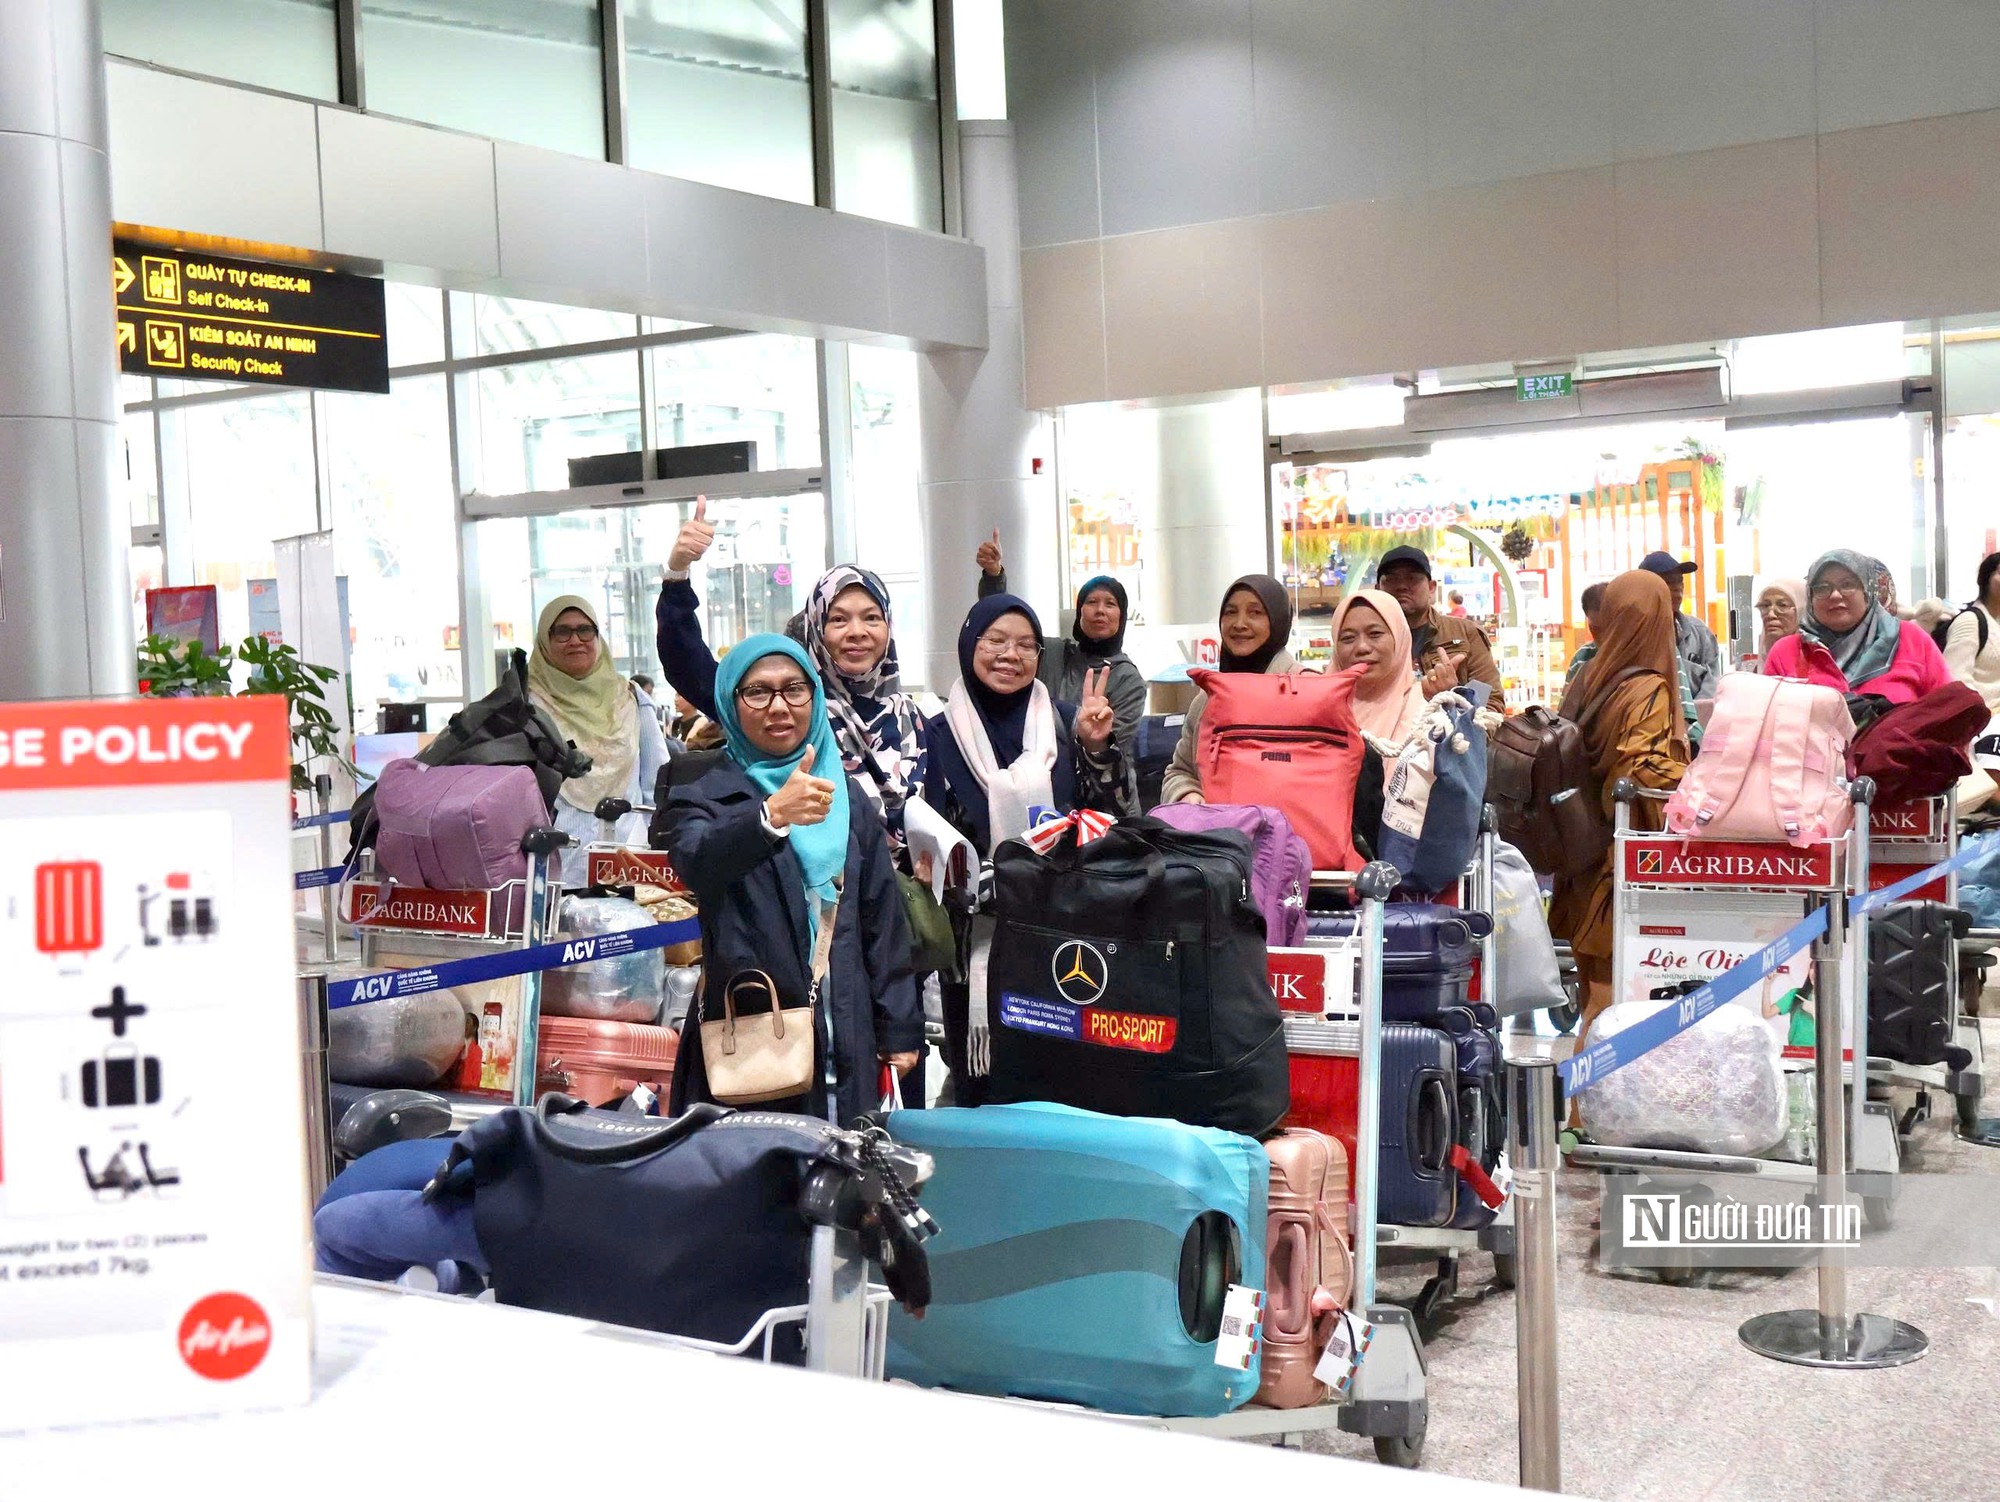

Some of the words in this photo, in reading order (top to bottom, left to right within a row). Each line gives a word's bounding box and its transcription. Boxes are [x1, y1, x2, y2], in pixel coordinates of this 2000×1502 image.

[250, 273, 311, 293] CHECK-IN
[187, 290, 212, 306] Self
[215, 293, 269, 313] Check-in
[264, 335, 283, 350] AN
[286, 337, 316, 353] NINH
[191, 353, 242, 374] Security
[244, 358, 283, 375] Check
[1524, 375, 1565, 391] EXIT
[60, 721, 254, 767] POLICY
[1666, 855, 1818, 877] AGRIBANK
[378, 901, 477, 925] AGRIBANK
[562, 939, 596, 962] ACV
[1639, 947, 1688, 972] Lộc
[351, 975, 393, 1002] ACV
[1007, 1005, 1027, 1015] LONDON
[1679, 996, 1695, 1028] ACV
[1092, 1012, 1166, 1044] PRO-SPORT
[1569, 1054, 1592, 1091] ACV
